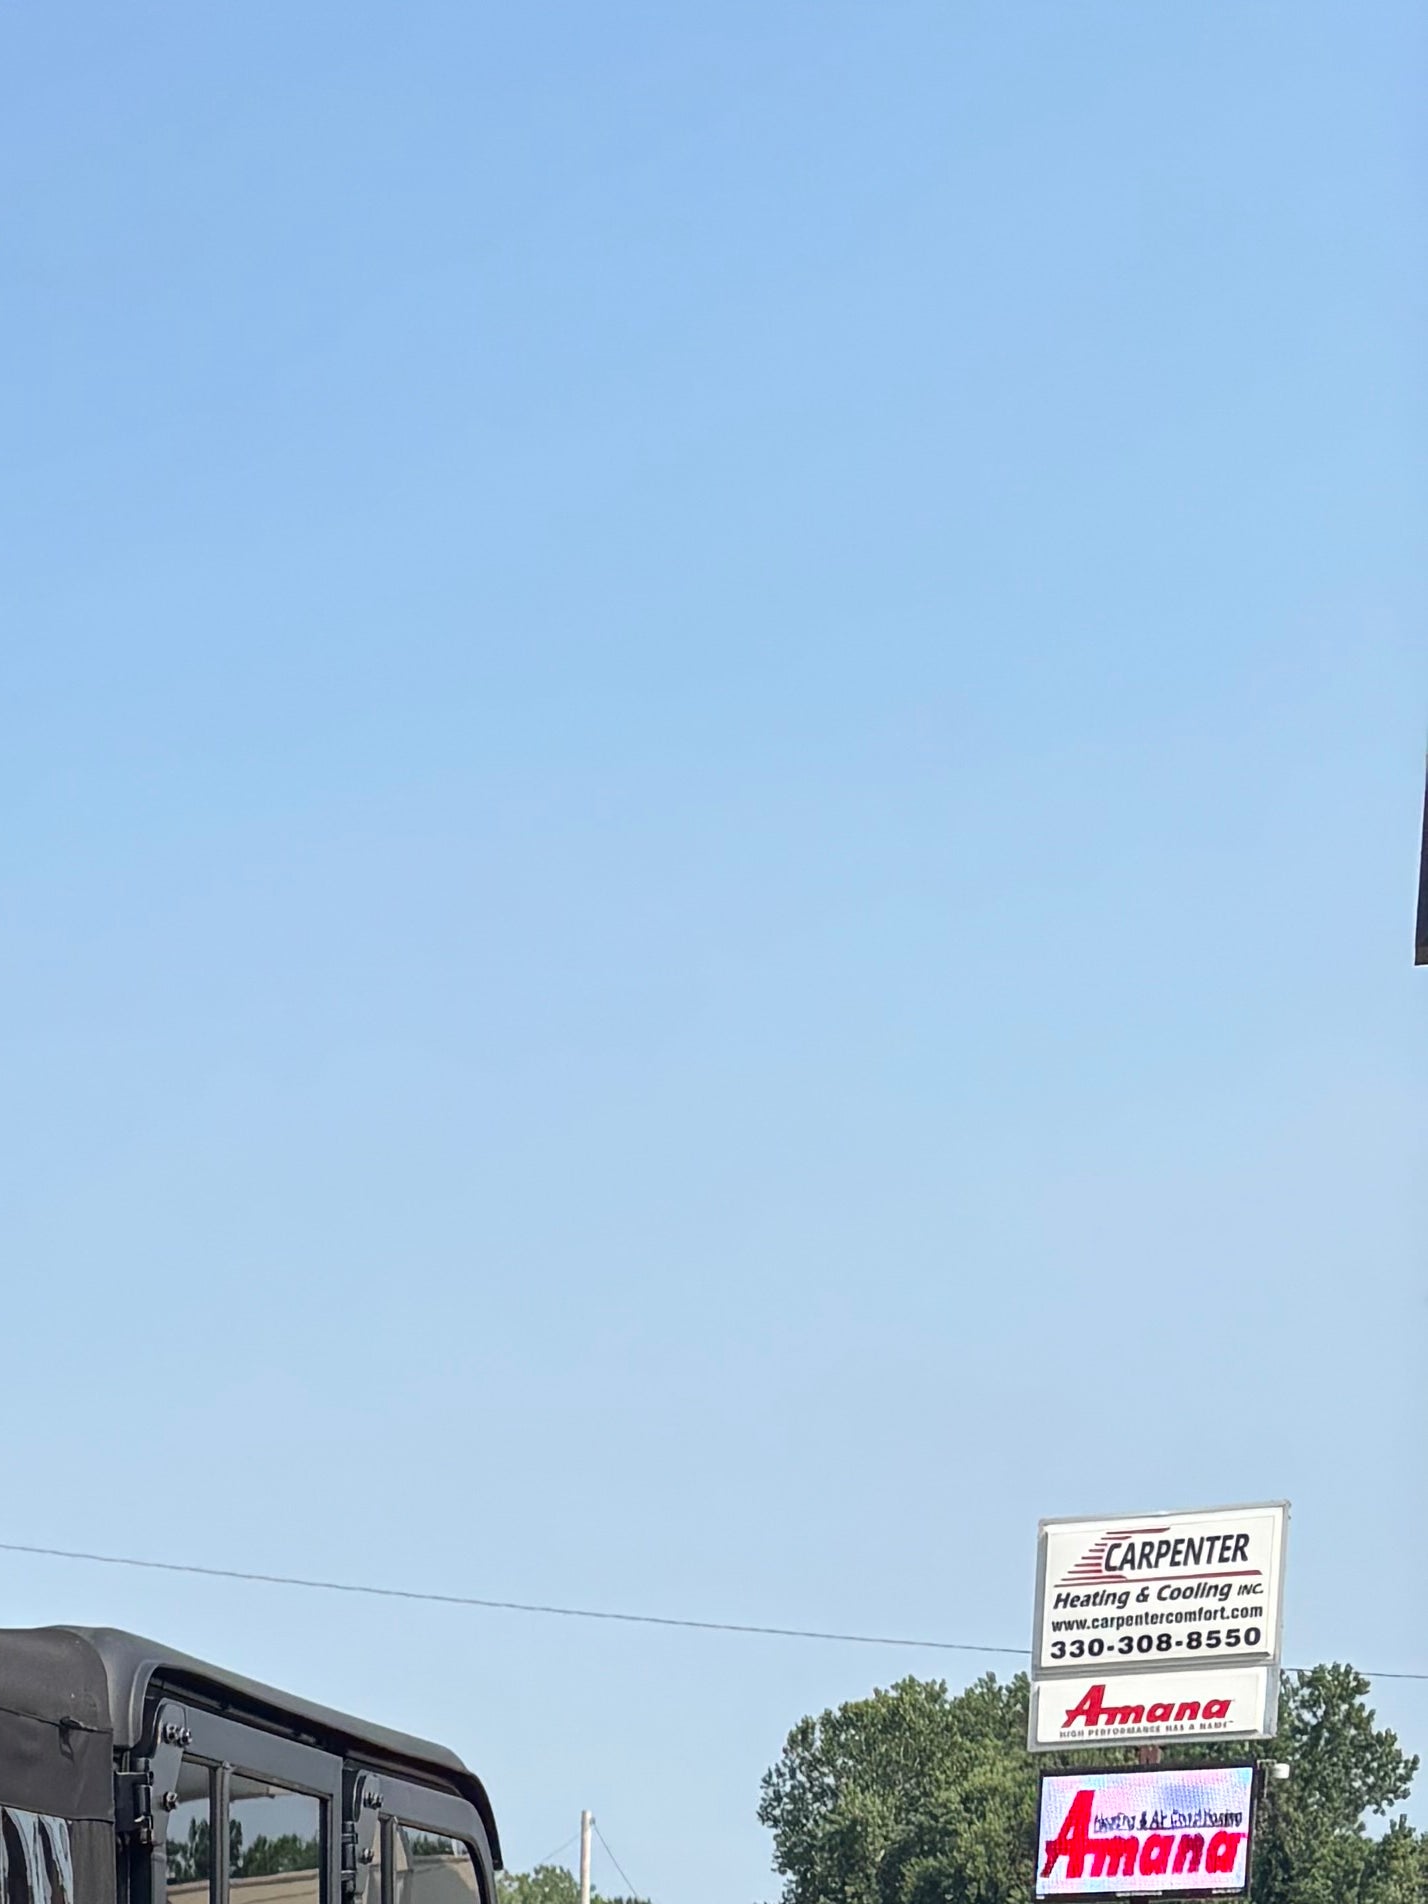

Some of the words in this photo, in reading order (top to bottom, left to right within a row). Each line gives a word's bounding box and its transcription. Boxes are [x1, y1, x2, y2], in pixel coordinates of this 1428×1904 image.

[1104, 1533, 1250, 1573] CARPENTER
[1053, 1589, 1131, 1609] Heating
[1135, 1586, 1150, 1603] &
[1156, 1582, 1233, 1602] Cooling
[1237, 1582, 1264, 1597] INC.
[1051, 1605, 1263, 1633] www.carpentercomfort.com
[1050, 1626, 1261, 1660] 330-308-8550
[1060, 1684, 1232, 1728] Amana
[1040, 1789, 1243, 1879] Amana
